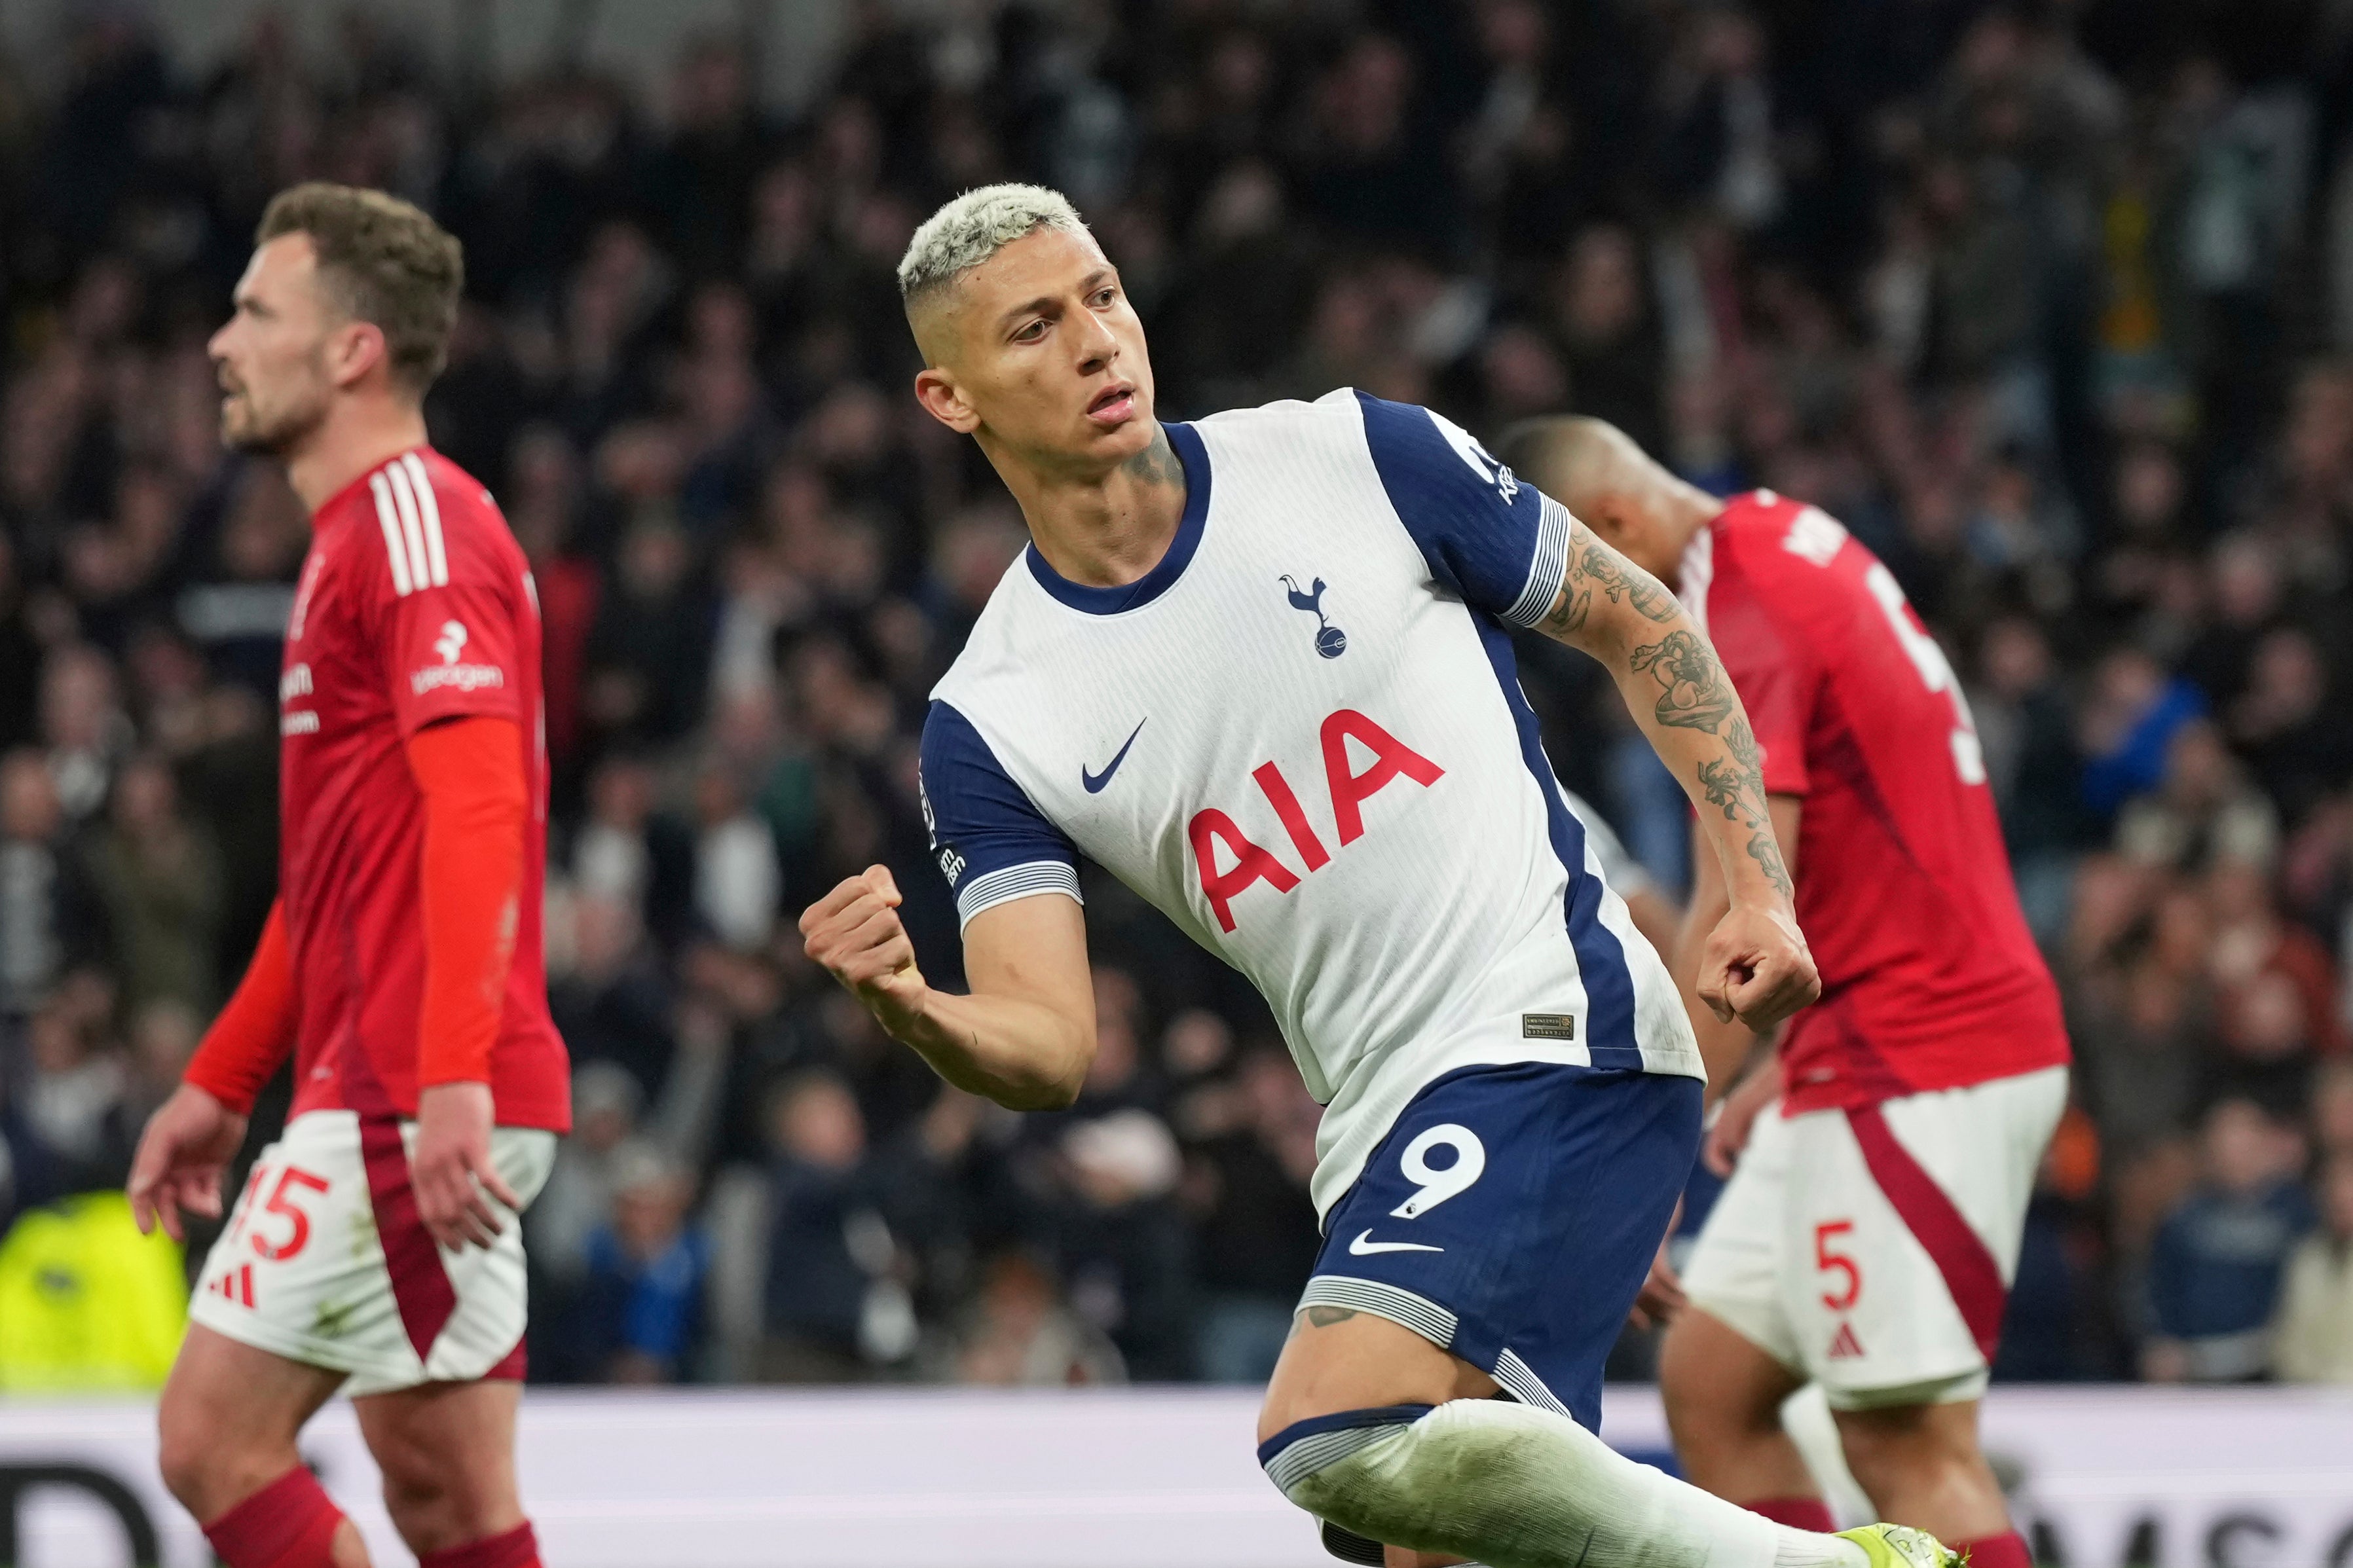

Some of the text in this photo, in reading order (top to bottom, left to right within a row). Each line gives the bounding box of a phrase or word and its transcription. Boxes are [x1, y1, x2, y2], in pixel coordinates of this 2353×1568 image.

[1188, 709, 1446, 934] AIA
[1389, 1123, 1485, 1220] 9
[1815, 1220, 1861, 1311] 5
